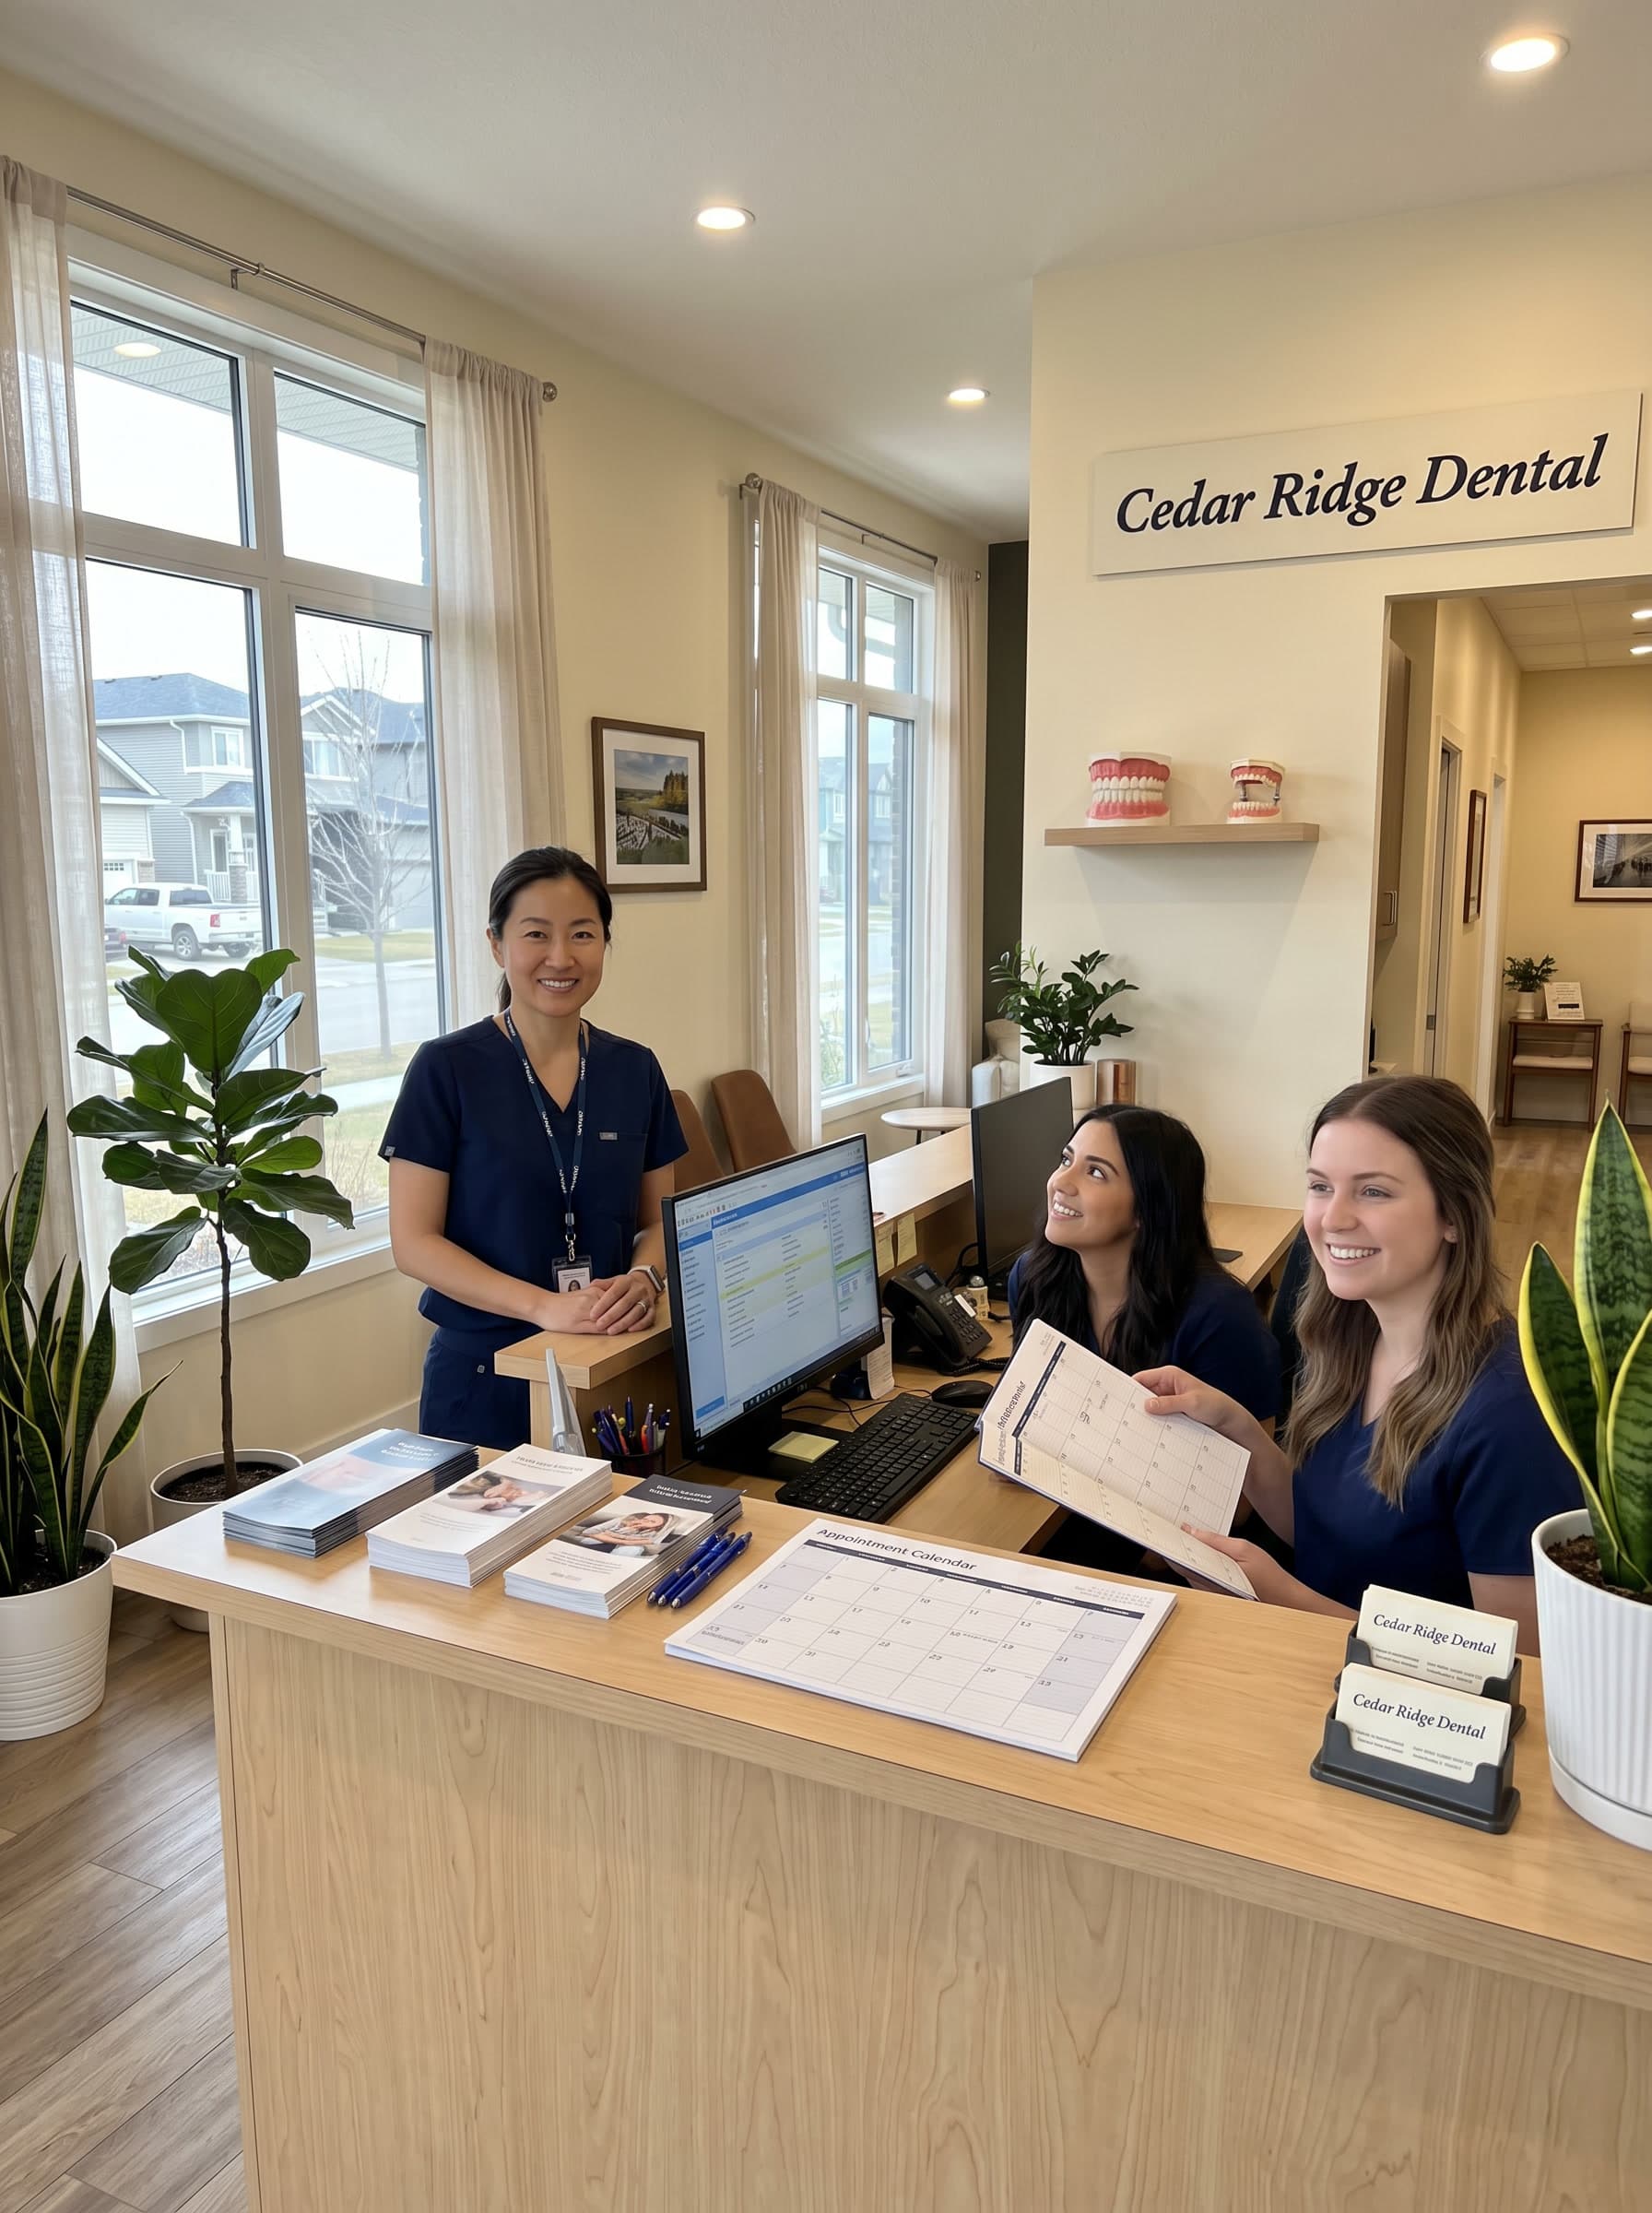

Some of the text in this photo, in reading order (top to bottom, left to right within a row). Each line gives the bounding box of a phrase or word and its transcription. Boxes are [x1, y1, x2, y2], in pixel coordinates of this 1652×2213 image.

[1116, 433, 1610, 533] Cedar Ridge Dental
[817, 1528, 977, 1571] Appointment Calendar
[1374, 1614, 1497, 1655] Cedar Ridge Dental
[1353, 1693, 1487, 1740] Cedar Ridge Dental
